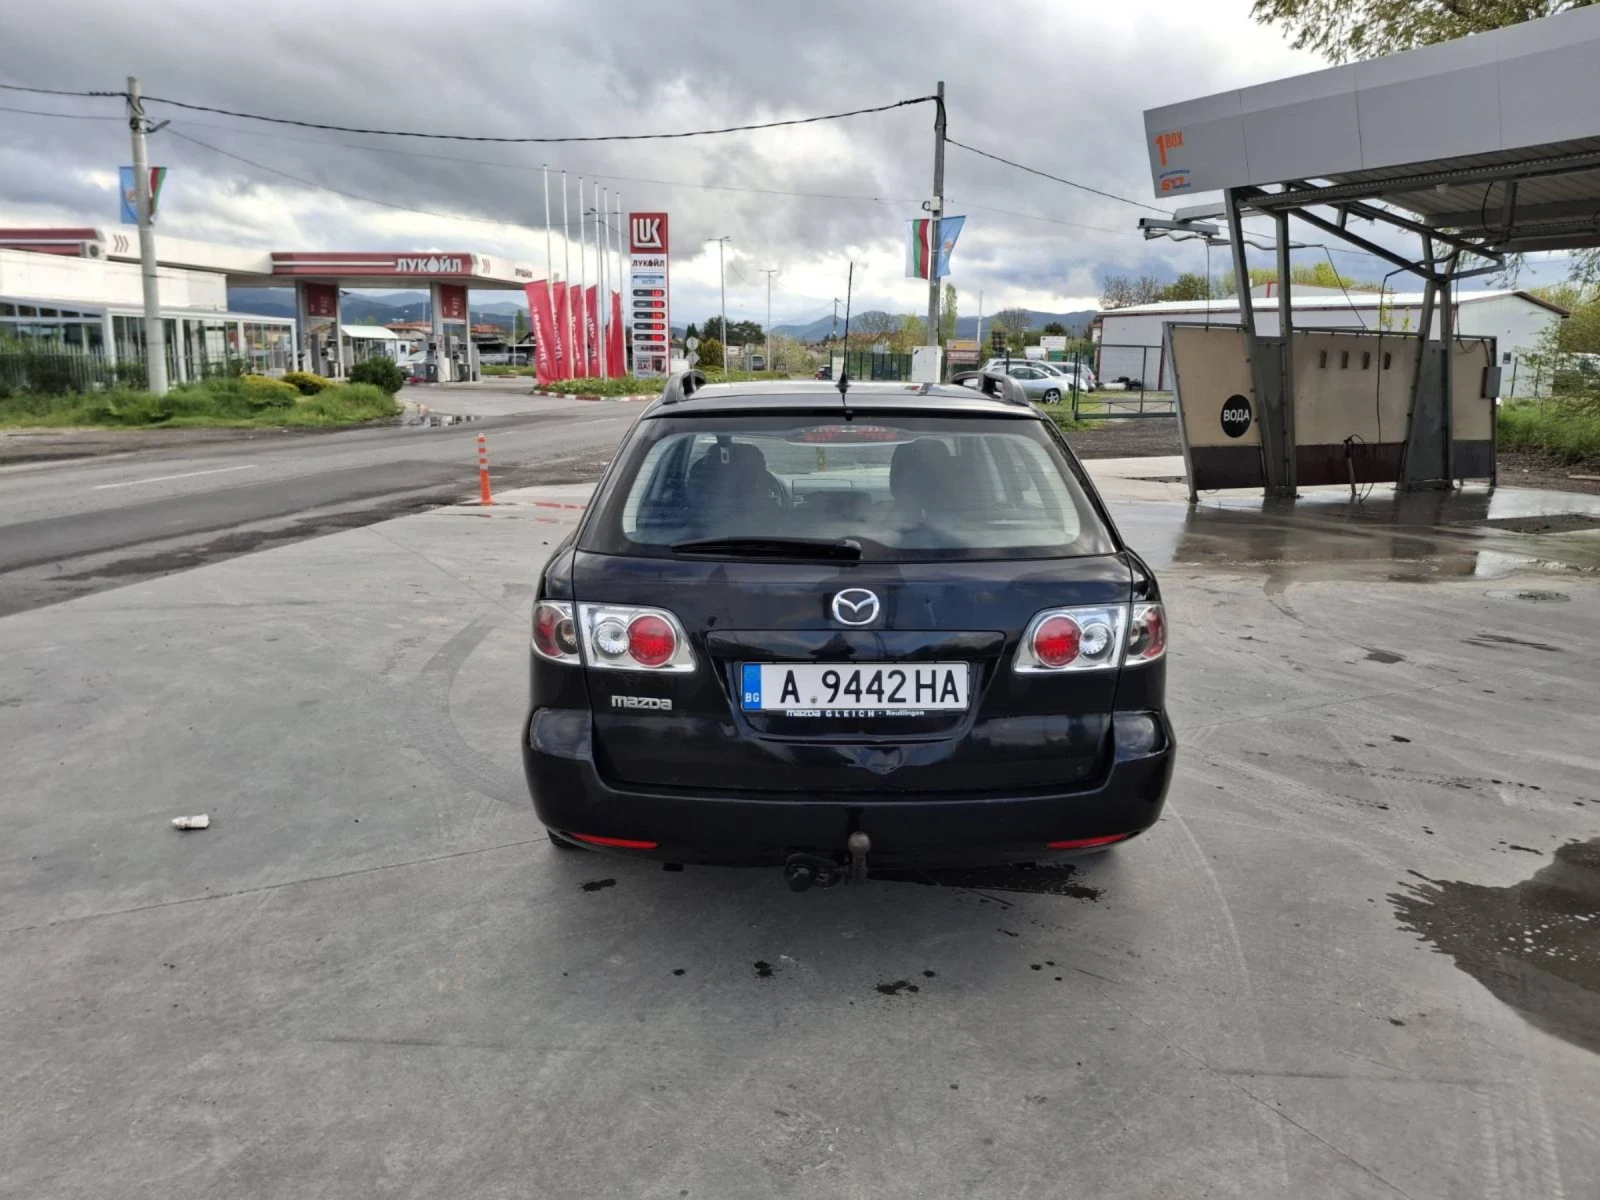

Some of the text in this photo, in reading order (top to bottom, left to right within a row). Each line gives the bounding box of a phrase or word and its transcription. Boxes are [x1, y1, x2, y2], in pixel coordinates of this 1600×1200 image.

[396, 256, 462, 273] ЛУКОЙЛ
[632, 259, 665, 267] ЛУКОЙЛ
[1223, 409, 1250, 423] ВОДА
[780, 670, 800, 703] A
[821, 669, 907, 703] 9442
[611, 695, 673, 711] mazda
[745, 692, 760, 703] BG
[826, 709, 875, 718] GLEICH
